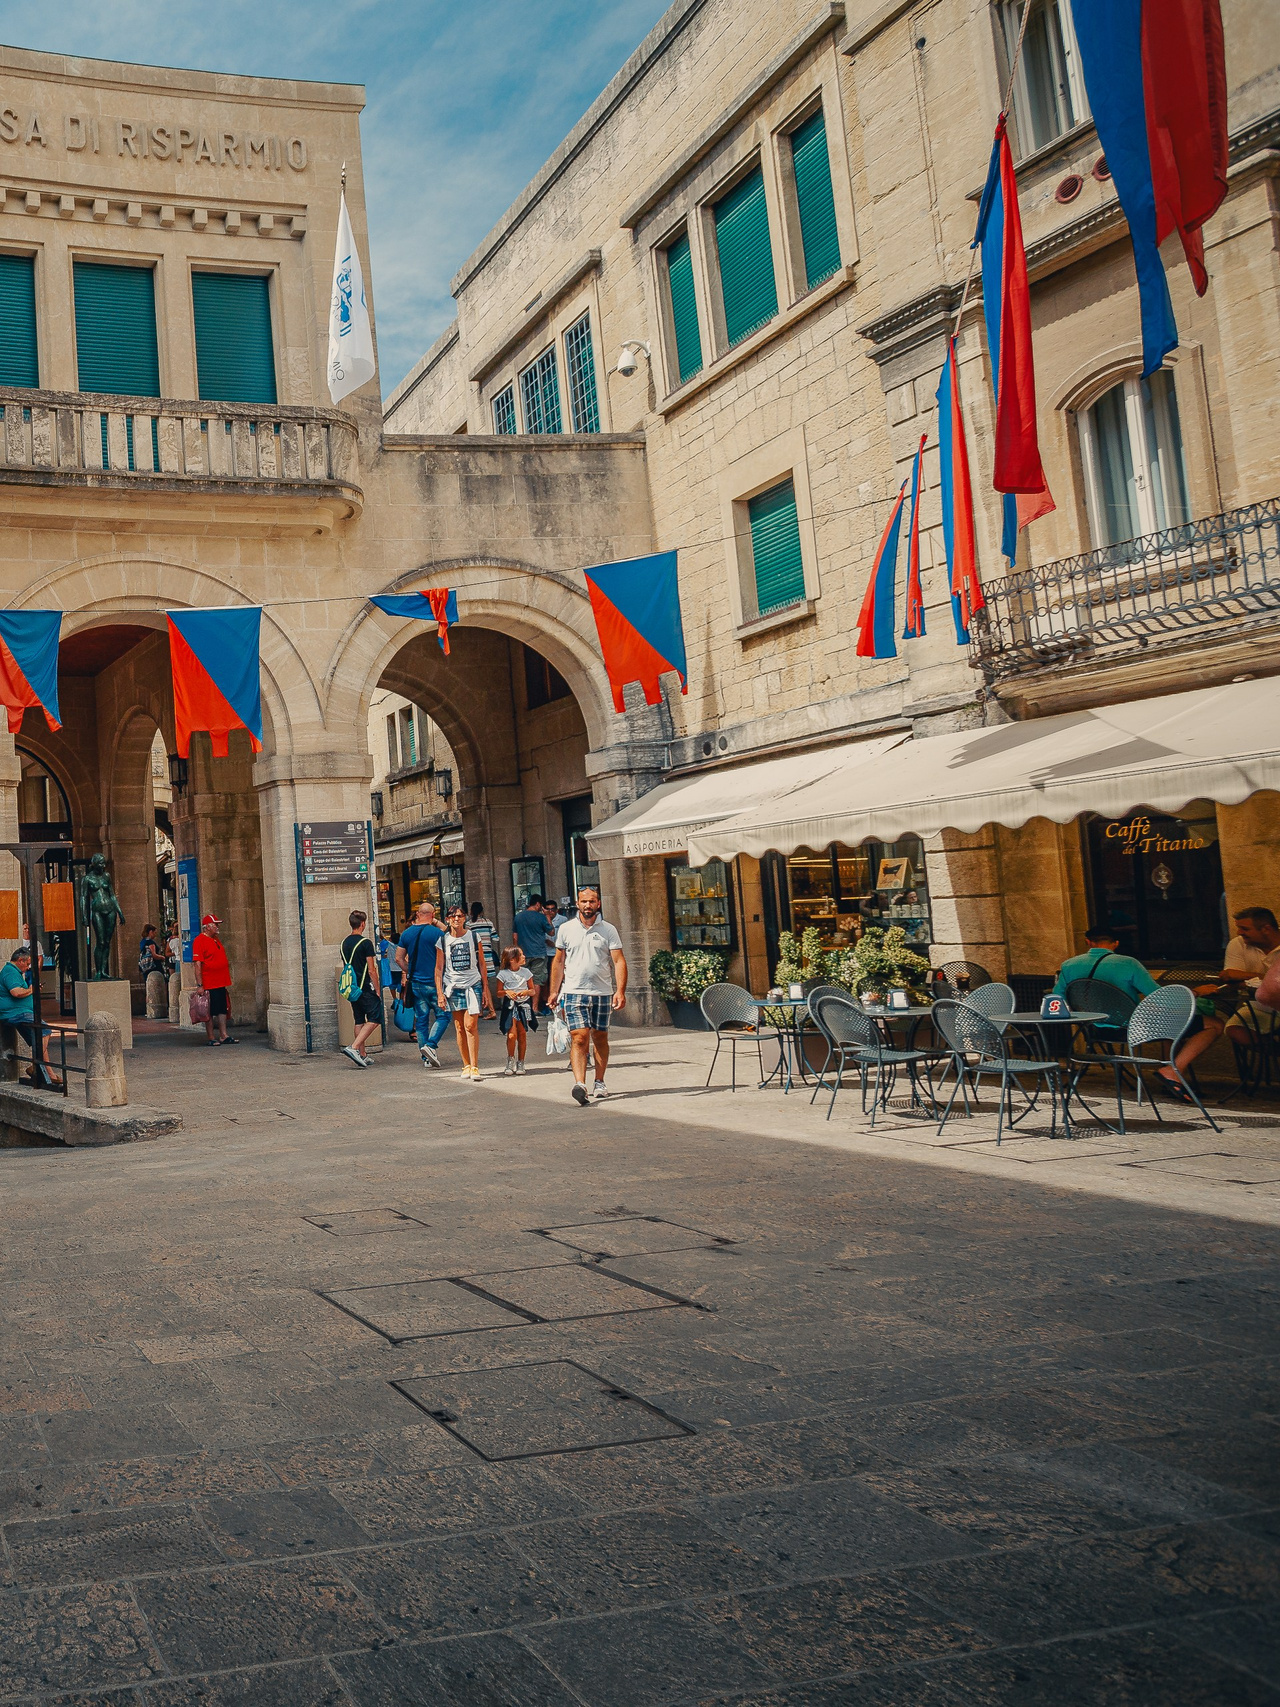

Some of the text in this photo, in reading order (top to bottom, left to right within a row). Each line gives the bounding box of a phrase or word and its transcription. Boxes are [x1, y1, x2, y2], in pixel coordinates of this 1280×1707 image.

[64, 113, 100, 154] DI
[117, 122, 308, 173] RISPARMIO
[1105, 816, 1151, 844] Caffè
[1122, 833, 1204, 855] del Titano
